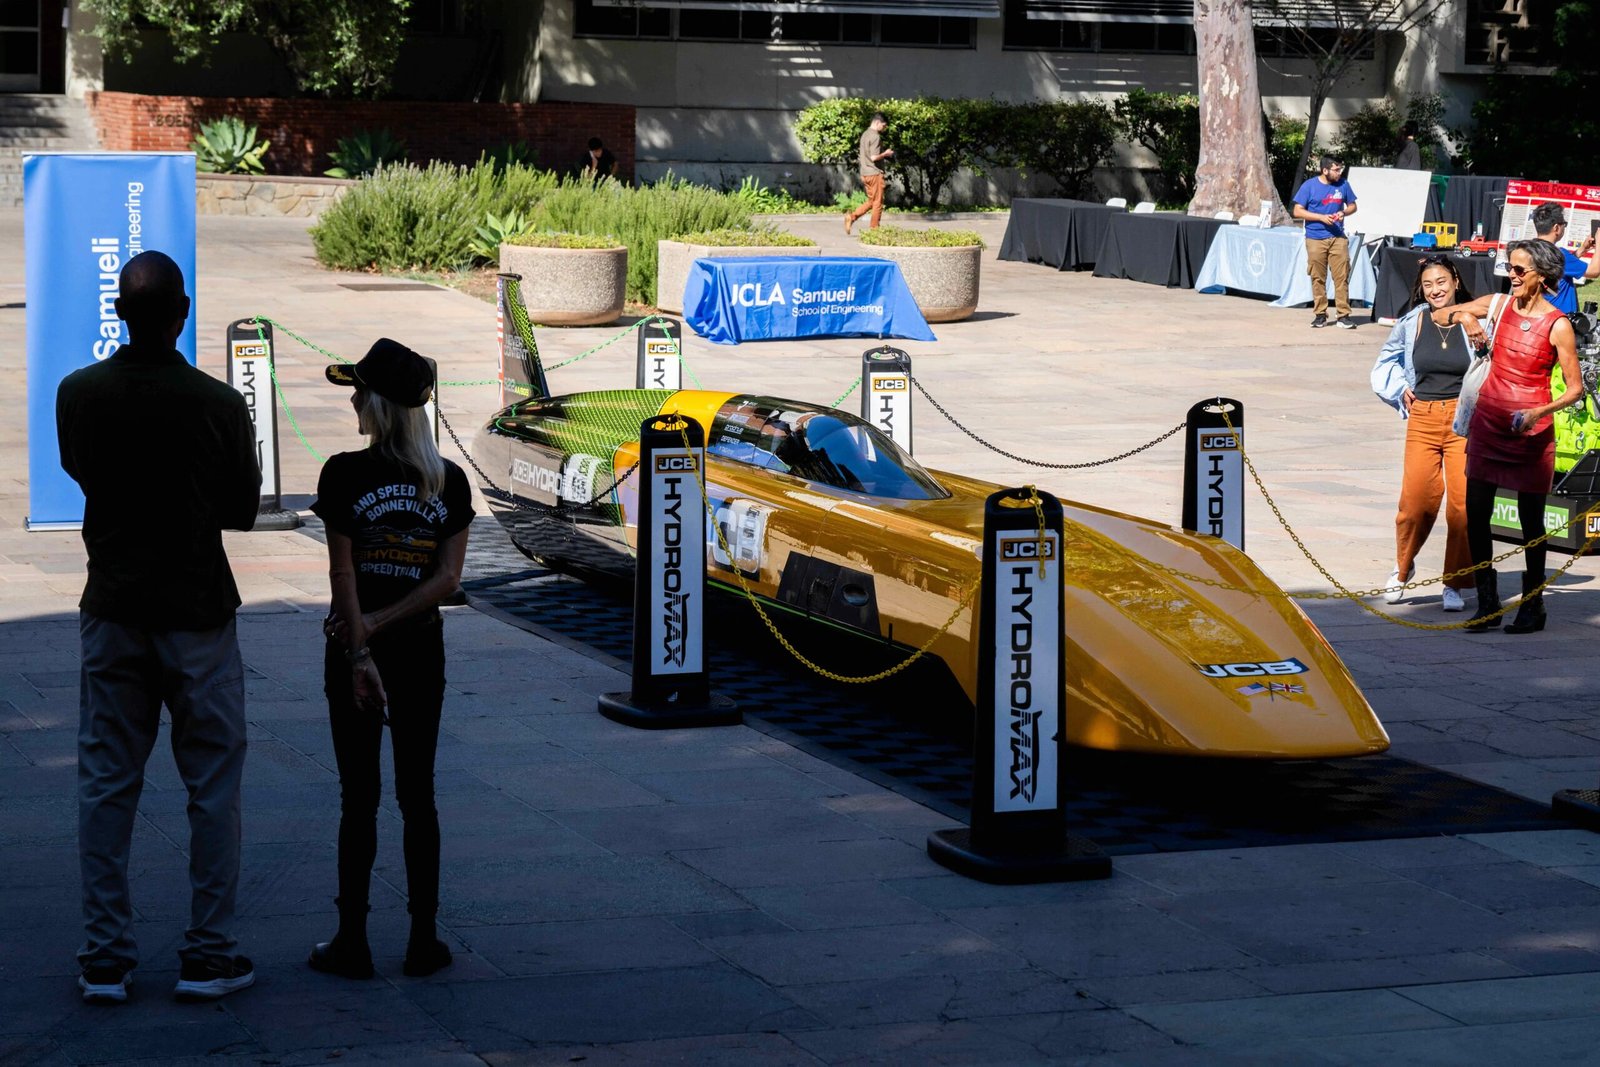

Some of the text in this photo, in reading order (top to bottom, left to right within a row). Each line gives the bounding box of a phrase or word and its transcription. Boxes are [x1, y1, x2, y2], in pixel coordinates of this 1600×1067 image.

[125, 181, 144, 258] gineering
[792, 286, 855, 305] Samueli
[792, 304, 883, 317] School of Engineering
[237, 346, 265, 356] JCB
[650, 345, 676, 353] JCB
[875, 380, 905, 390] JCB
[1203, 437, 1236, 448] JCB
[658, 457, 696, 470] JCB
[377, 484, 416, 499] SPEED
[366, 499, 437, 523] BONNEVILLE
[1005, 542, 1052, 558] JCB
[361, 563, 393, 575] SPEED
[664, 478, 683, 667] HYDROMAX
[1199, 661, 1302, 678] JCB
[1010, 567, 1032, 803] HYDROMAX
